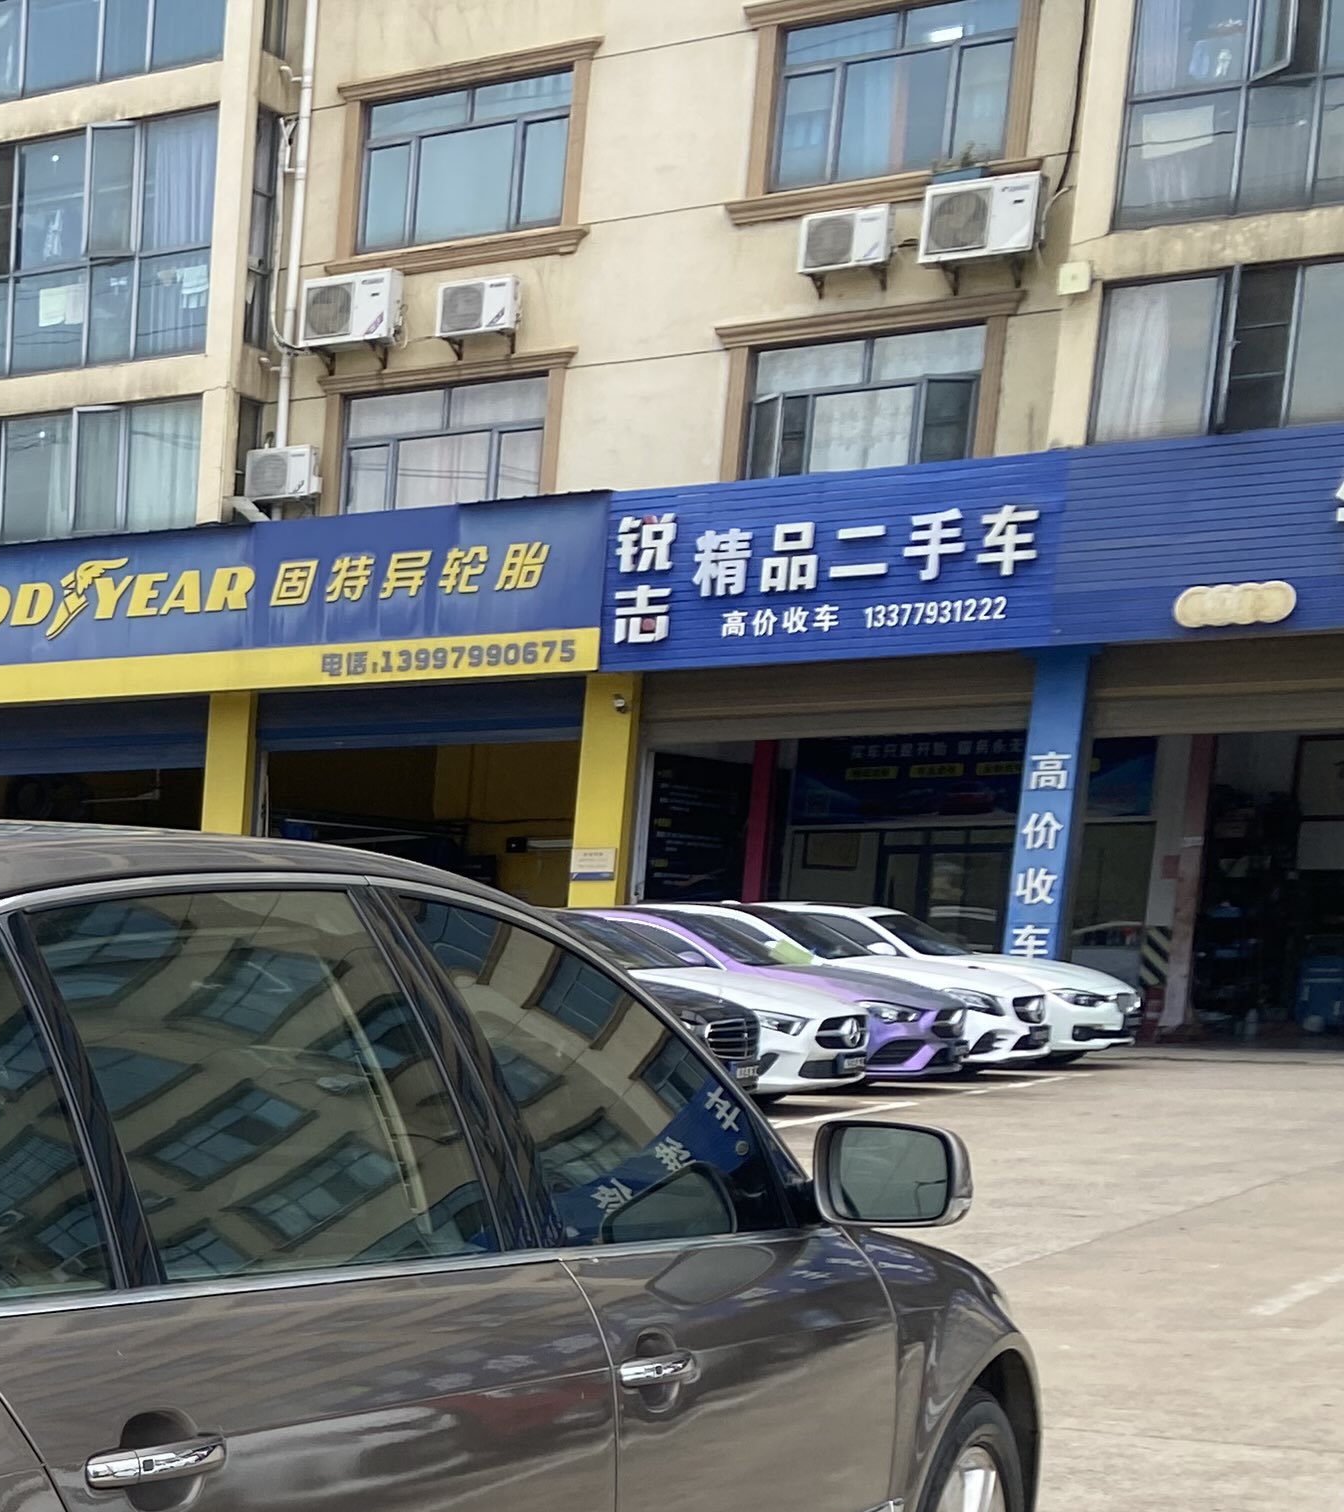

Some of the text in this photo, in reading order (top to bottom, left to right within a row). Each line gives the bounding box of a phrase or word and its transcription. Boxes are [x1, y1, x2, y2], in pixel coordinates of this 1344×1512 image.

[270, 541, 550, 607] 固特异轮胎
[613, 512, 677, 644] 锐志
[693, 504, 1040, 597] 精品二手车
[721, 596, 1008, 637] 高价收车 13377931222
[1009, 752, 1072, 959] 高价收车
